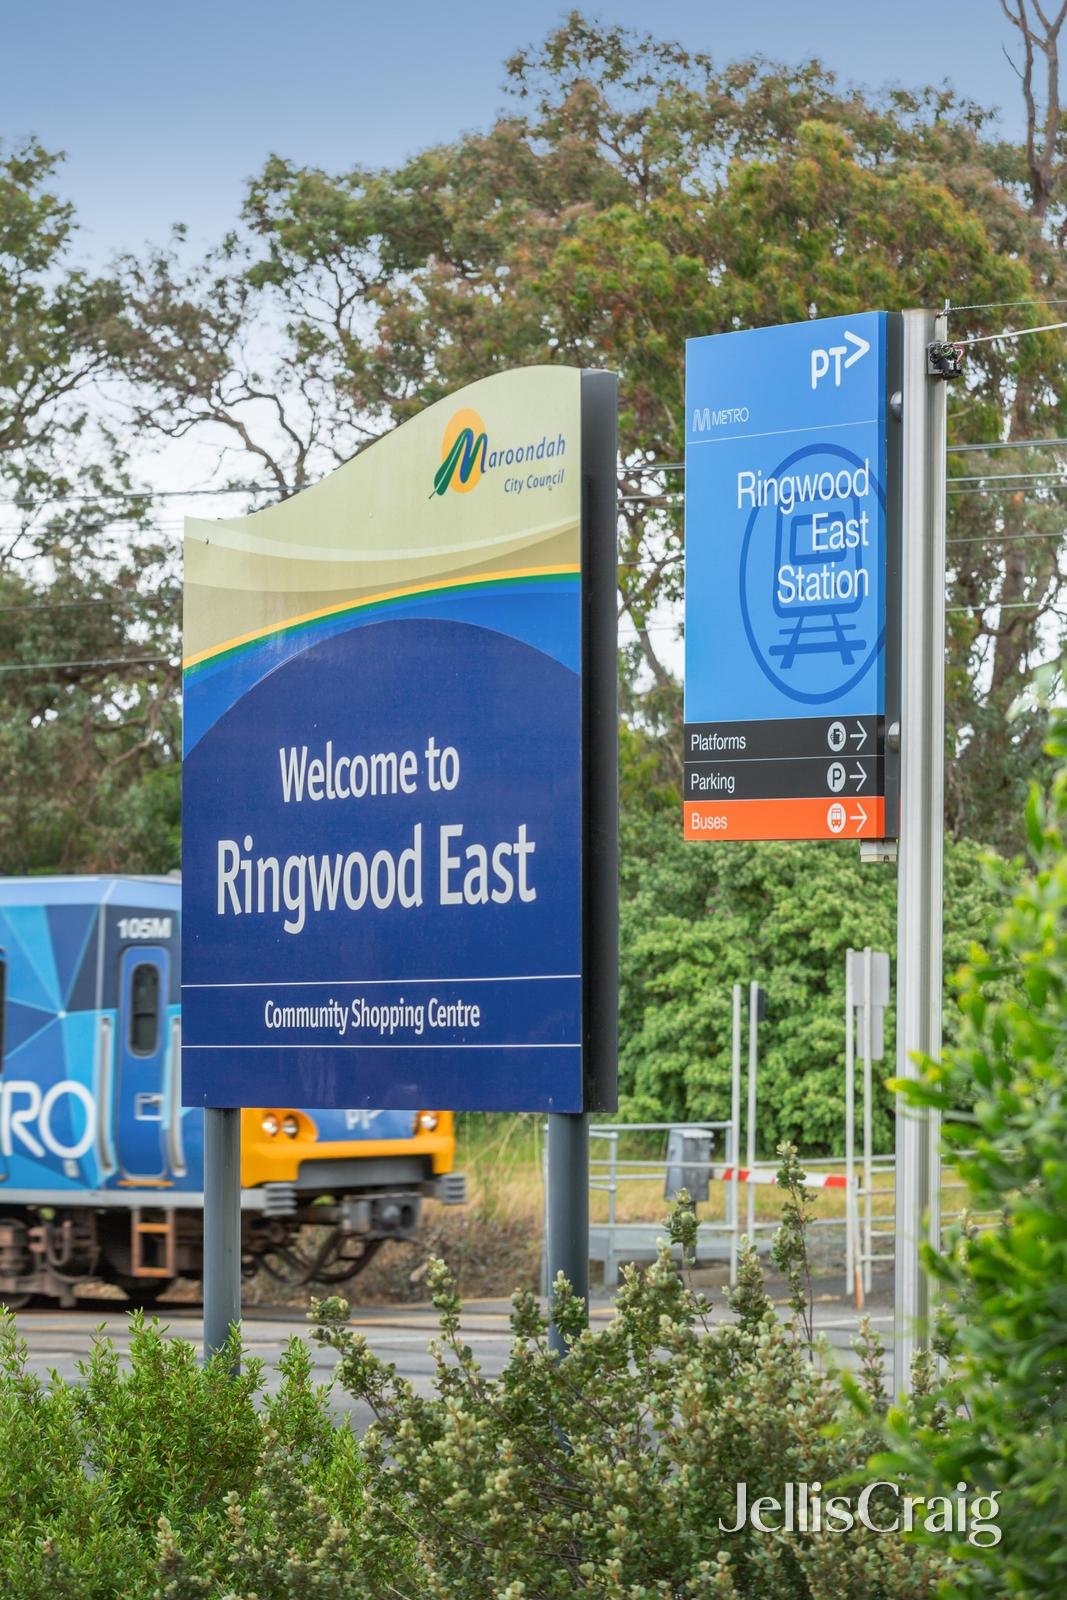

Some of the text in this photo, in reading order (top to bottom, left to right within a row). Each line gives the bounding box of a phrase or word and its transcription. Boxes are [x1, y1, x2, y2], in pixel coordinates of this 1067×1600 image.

[811, 346, 847, 390] PT
[711, 407, 750, 426] METRO
[428, 427, 567, 500] Maroondah
[504, 468, 565, 496] City Council
[737, 458, 870, 515] Ringwood
[811, 511, 870, 551] East
[776, 561, 870, 604] Station
[690, 733, 746, 751] Platforms
[279, 736, 460, 803] Welcome to
[690, 772, 735, 793] Parking
[691, 811, 728, 830] Buses
[217, 823, 537, 935] Ringwood East
[116, 917, 172, 939] 105M
[264, 998, 481, 1035] Community Shopping Centre
[0, 1080, 97, 1160] RO
